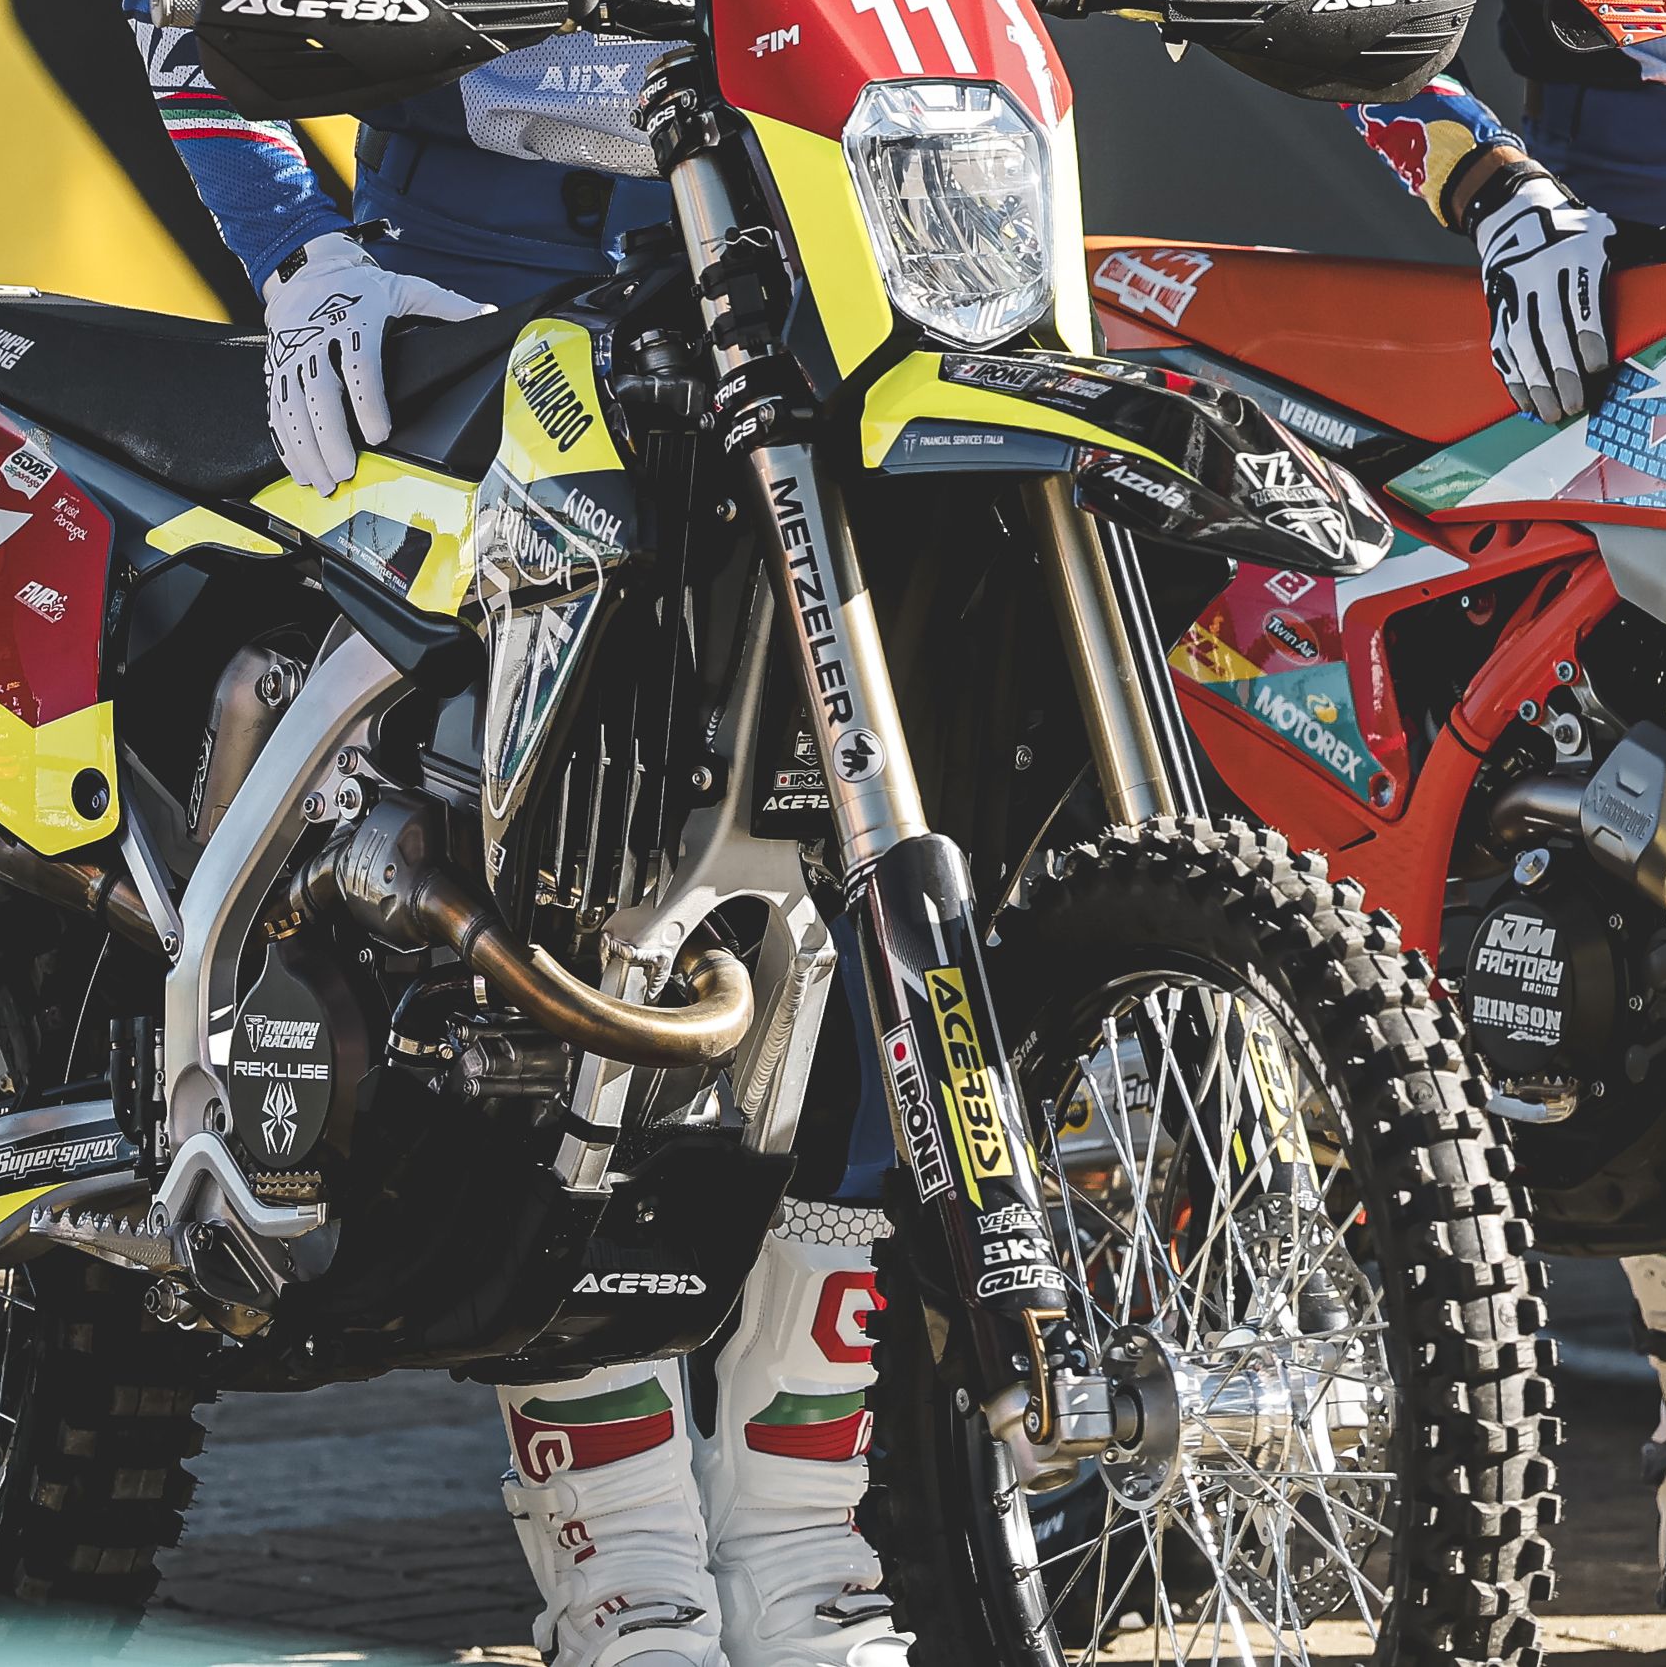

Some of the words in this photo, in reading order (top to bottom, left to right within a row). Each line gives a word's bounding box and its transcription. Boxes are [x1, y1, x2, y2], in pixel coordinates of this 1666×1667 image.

[754, 24, 801, 59] FIM
[327, 307, 347, 326] 3D
[520, 356, 594, 454] ZANARDO
[1279, 398, 1358, 450] VERONA
[919, 435, 952, 447] FINANCIAL
[953, 435, 982, 446] SERVICES
[983, 434, 1004, 446] ITALIA
[1102, 465, 1185, 511] Azzola
[53, 513, 88, 542] Portugal
[563, 487, 622, 544] AIROH
[495, 498, 574, 591] TRIUMPH
[769, 475, 854, 728] METZELER
[1254, 686, 1363, 783] MOTOREX
[1485, 913, 1556, 957] KTM
[1475, 947, 1564, 985] FACTORY
[1522, 981, 1559, 998] RACING
[264, 1020, 321, 1040] TRIUMPH
[1473, 995, 1562, 1031] HINSON
[261, 1033, 316, 1051] RACING
[233, 1060, 330, 1081] REKLUSE
[932, 973, 997, 1177] ACERBIS
[895, 1066, 947, 1197] IPONE
[572, 1271, 708, 1297] ACERBIS
